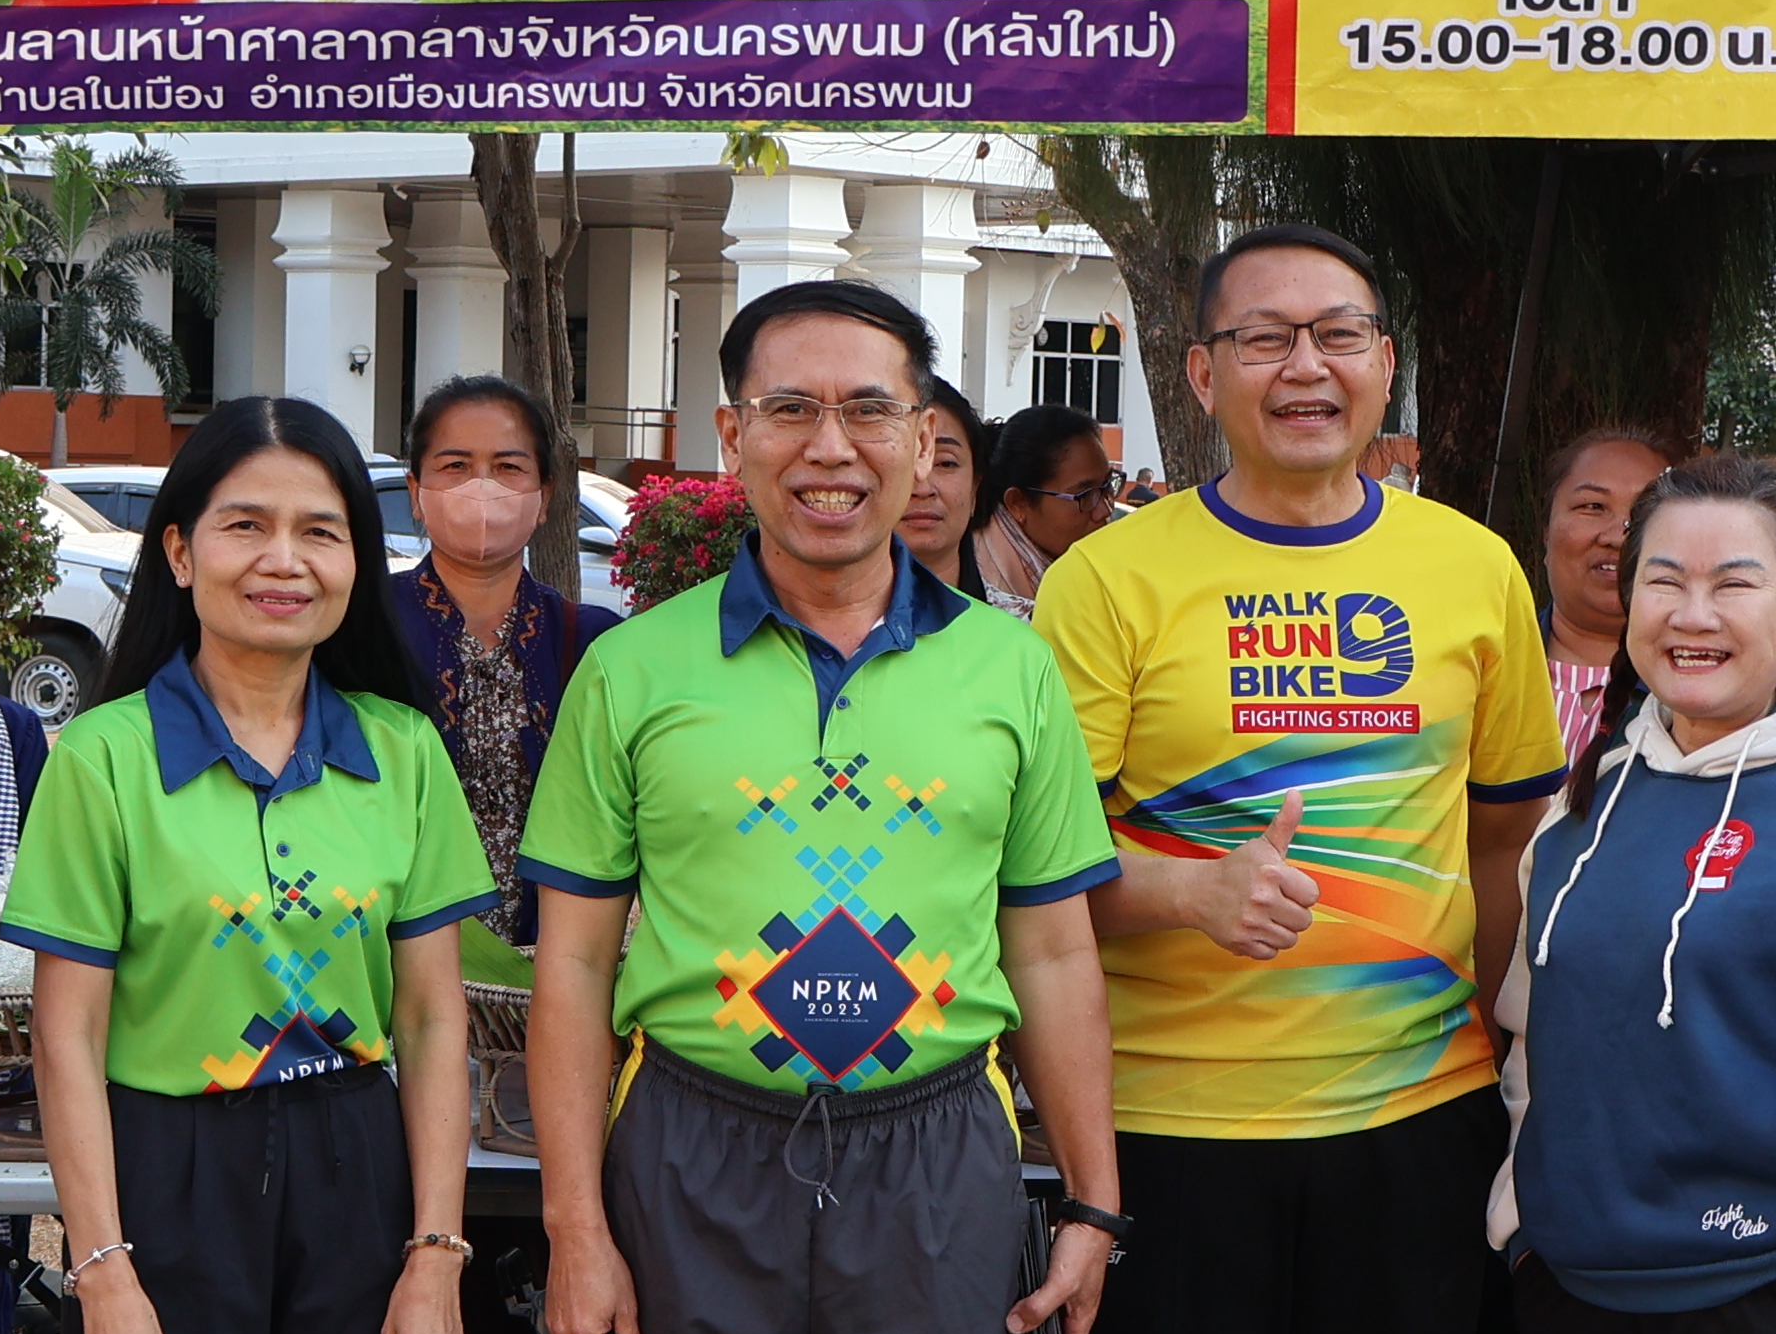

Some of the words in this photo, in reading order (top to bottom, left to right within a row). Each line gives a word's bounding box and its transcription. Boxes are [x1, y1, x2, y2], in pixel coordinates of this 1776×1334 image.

[944, 10, 1177, 68] (หลังใหม่)
[250, 72, 646, 111] อำเภอเมืองนครพนม
[659, 72, 972, 110] จังหวัดนครพนม
[1224, 591, 1328, 620] WALK
[1229, 620, 1332, 659] RUN
[1335, 592, 1414, 697] 9
[1230, 665, 1336, 698] BIKE
[1238, 709, 1334, 728] FIGHTING
[1337, 709, 1414, 728] STROKE
[792, 979, 878, 1001] NPKM
[807, 1002, 862, 1016] 2023
[1701, 1203, 1743, 1230] Fight
[1732, 1215, 1769, 1240] Club
